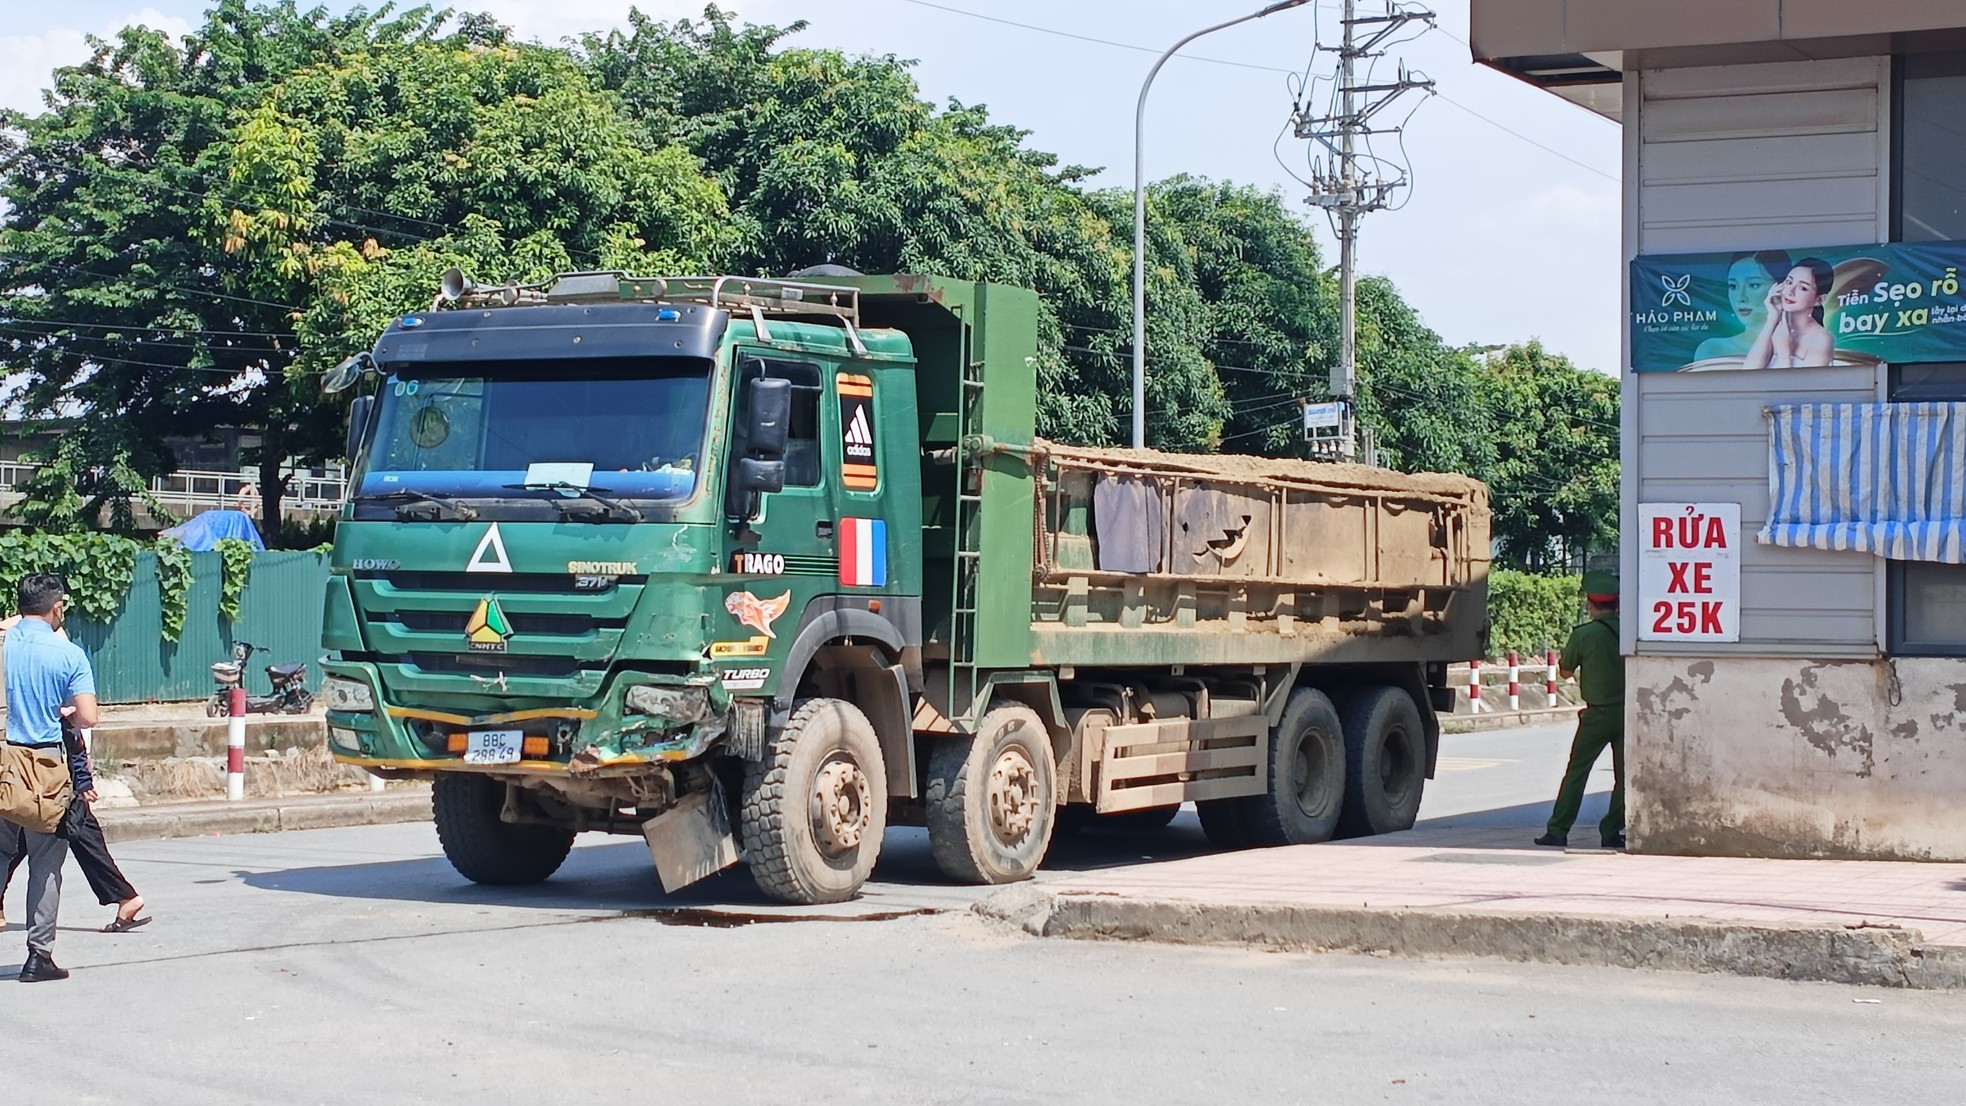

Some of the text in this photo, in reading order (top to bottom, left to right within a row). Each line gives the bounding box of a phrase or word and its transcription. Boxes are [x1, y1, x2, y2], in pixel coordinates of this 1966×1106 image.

[1837, 267, 1959, 307] Tiễn Sẹo rỗ
[1839, 308, 1928, 334] bay xa
[1652, 505, 1727, 549] RỬA
[568, 560, 638, 575] SINOTRUK
[734, 553, 785, 575] TRAGO
[1667, 562, 1713, 594] XE
[1652, 600, 1724, 634] 25K
[723, 668, 771, 680] TURBO
[483, 733, 507, 747] 88C
